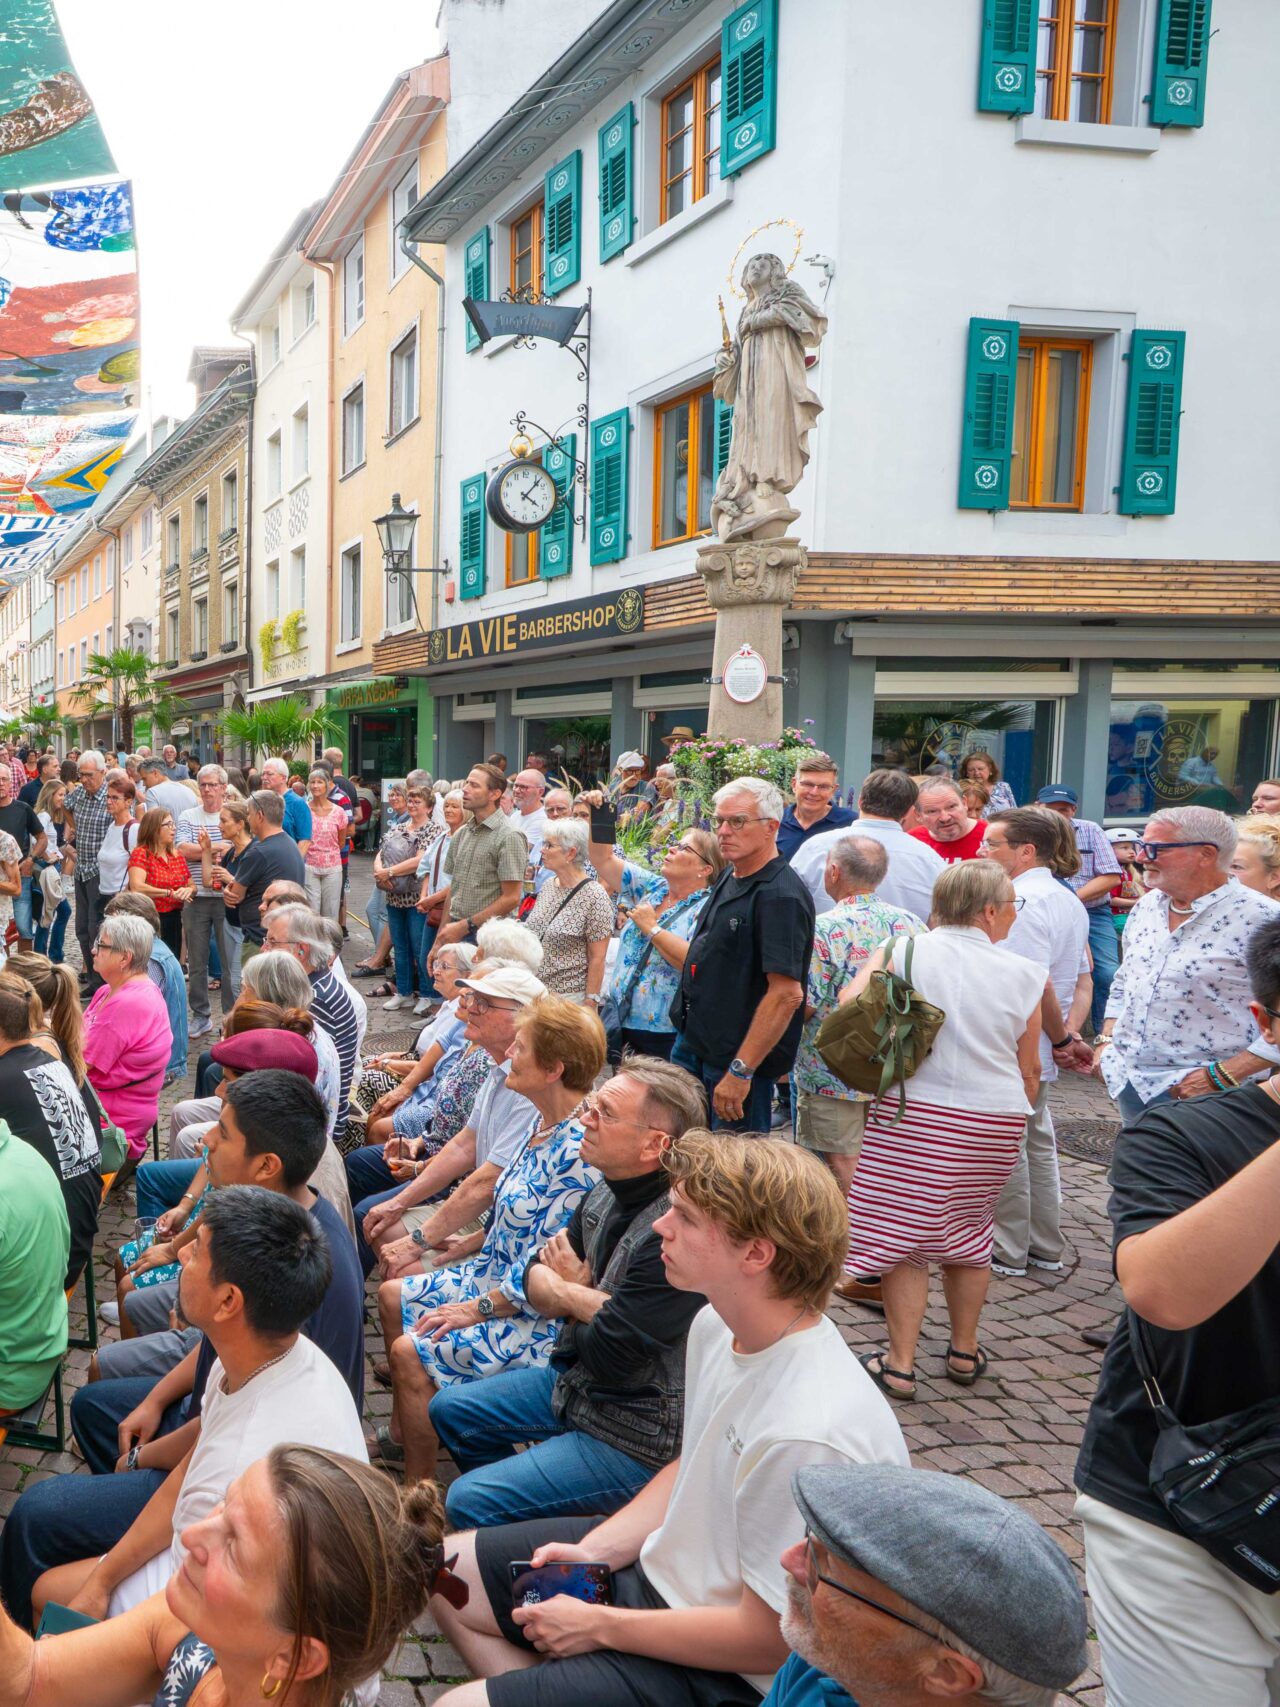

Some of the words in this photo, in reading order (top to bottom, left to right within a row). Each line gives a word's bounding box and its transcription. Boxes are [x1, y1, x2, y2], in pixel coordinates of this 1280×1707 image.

[446, 624, 474, 661] LA
[479, 614, 518, 655] VIE
[520, 604, 616, 641] BARBERSHOP
[338, 685, 364, 709] URFA
